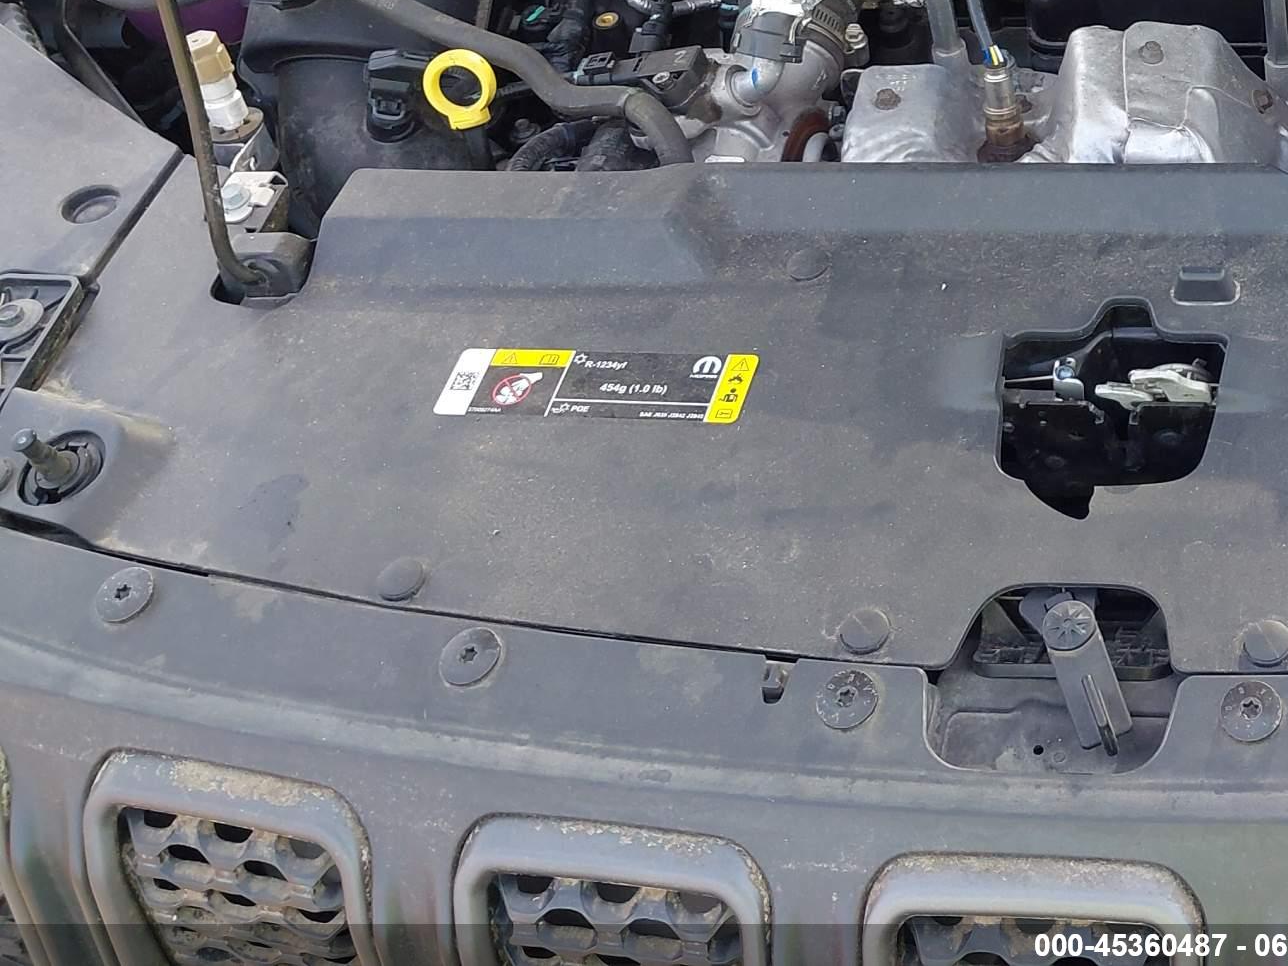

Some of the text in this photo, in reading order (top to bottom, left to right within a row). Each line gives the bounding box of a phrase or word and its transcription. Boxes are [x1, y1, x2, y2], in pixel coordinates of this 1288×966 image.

[584, 360, 628, 371] R-1234yf
[599, 383, 668, 395] 454g (1.0 lb)
